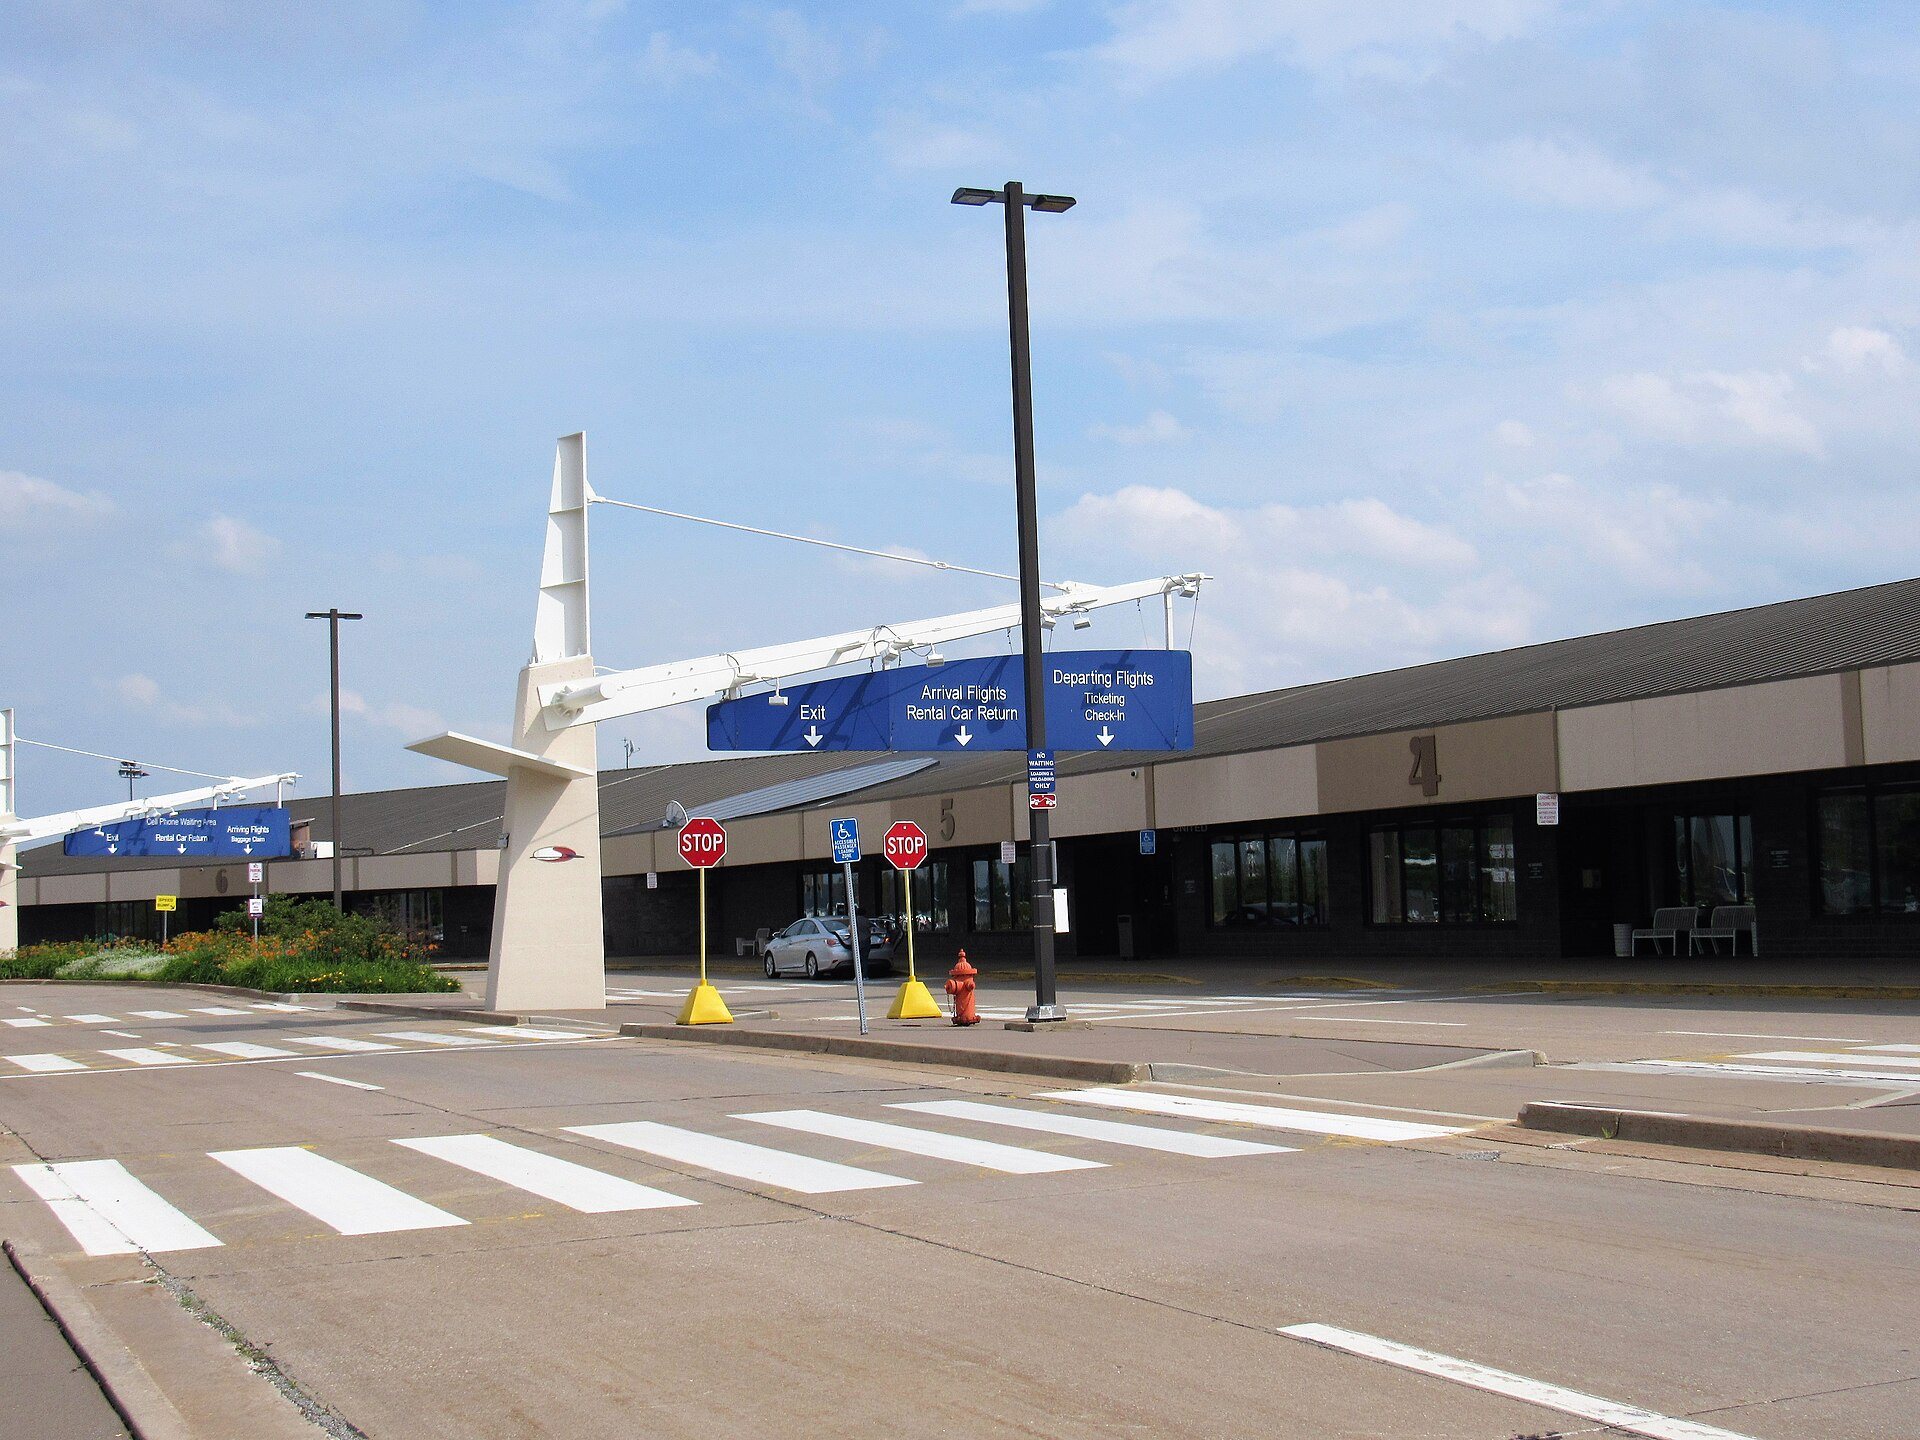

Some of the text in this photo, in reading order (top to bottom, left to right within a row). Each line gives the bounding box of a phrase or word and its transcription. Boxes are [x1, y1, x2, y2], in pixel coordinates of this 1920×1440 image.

[1053, 670, 1154, 688] Departing Flights
[921, 685, 1007, 703] Arrival Flights
[1084, 692, 1125, 706] Ticketing
[800, 704, 826, 720] Exit
[906, 705, 1018, 721] Rental Car Return
[1084, 709, 1125, 722] Check-In
[1409, 735, 1442, 796] 4
[146, 817, 217, 828] Cell Phone Waiting Area
[941, 799, 956, 841] 5
[106, 833, 120, 842] Exit
[155, 833, 208, 842] Rental Car Return
[227, 825, 270, 835] Arriving Flights
[682, 833, 724, 852] STOP
[887, 836, 924, 855] STOP
[215, 867, 229, 894] 6
